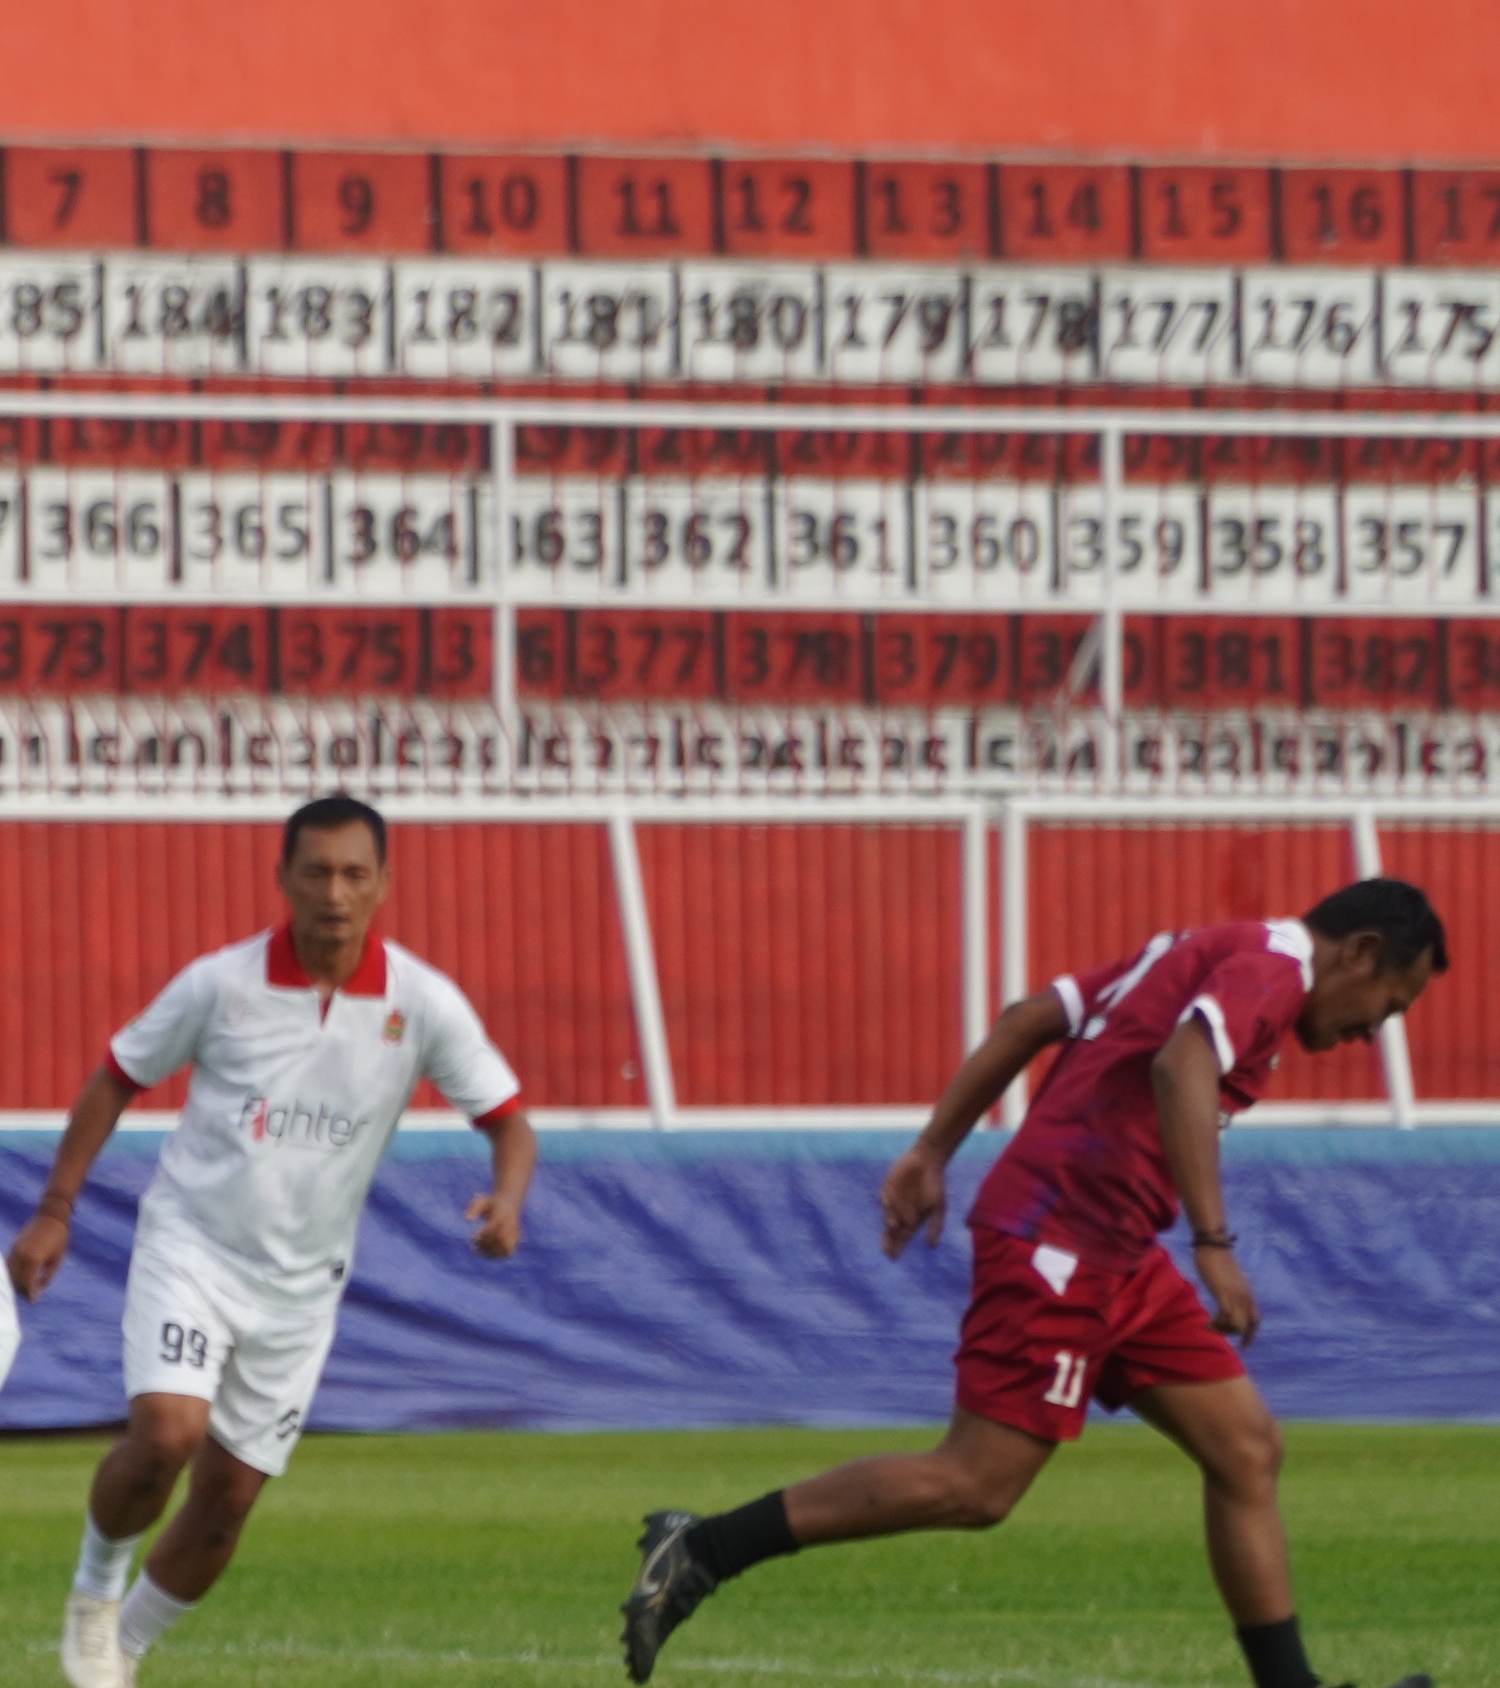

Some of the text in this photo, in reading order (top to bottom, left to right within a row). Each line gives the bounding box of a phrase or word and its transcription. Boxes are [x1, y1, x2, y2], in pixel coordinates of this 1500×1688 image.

[46, 170, 84, 229] 7
[195, 169, 233, 229] 8
[336, 174, 374, 235] 9
[463, 176, 539, 237] 10
[614, 179, 681, 238] 11
[735, 176, 813, 236] 12
[880, 179, 963, 239] 13
[1023, 181, 1102, 241] 14
[1159, 182, 1242, 240] 15
[1310, 184, 1384, 243] 16
[262, 284, 373, 347] 183
[412, 288, 522, 348] 182
[558, 290, 662, 349] 181
[700, 290, 806, 350] 180
[842, 295, 952, 353] 179
[982, 296, 1090, 353] 178
[1114, 298, 1221, 355] 177
[1255, 298, 1352, 355] 176
[1398, 301, 1495, 359] 175
[40, 502, 160, 559] 366
[190, 502, 310, 562] 365
[346, 504, 460, 566] 364
[640, 512, 753, 571] 362
[788, 513, 896, 574] 361
[928, 515, 1043, 574] 360
[1070, 516, 1186, 576] 359
[1213, 518, 1327, 577] 358
[1355, 518, 1467, 578] 357
[140, 619, 253, 682] 374
[288, 622, 404, 685] 375
[438, 626, 557, 686] 36
[586, 627, 707, 686] 377
[882, 631, 998, 691] 379
[1032, 633, 1145, 691] 30
[1178, 631, 1285, 693] 381
[1320, 633, 1428, 694] 382
[1043, 1350, 1087, 1408] 11
